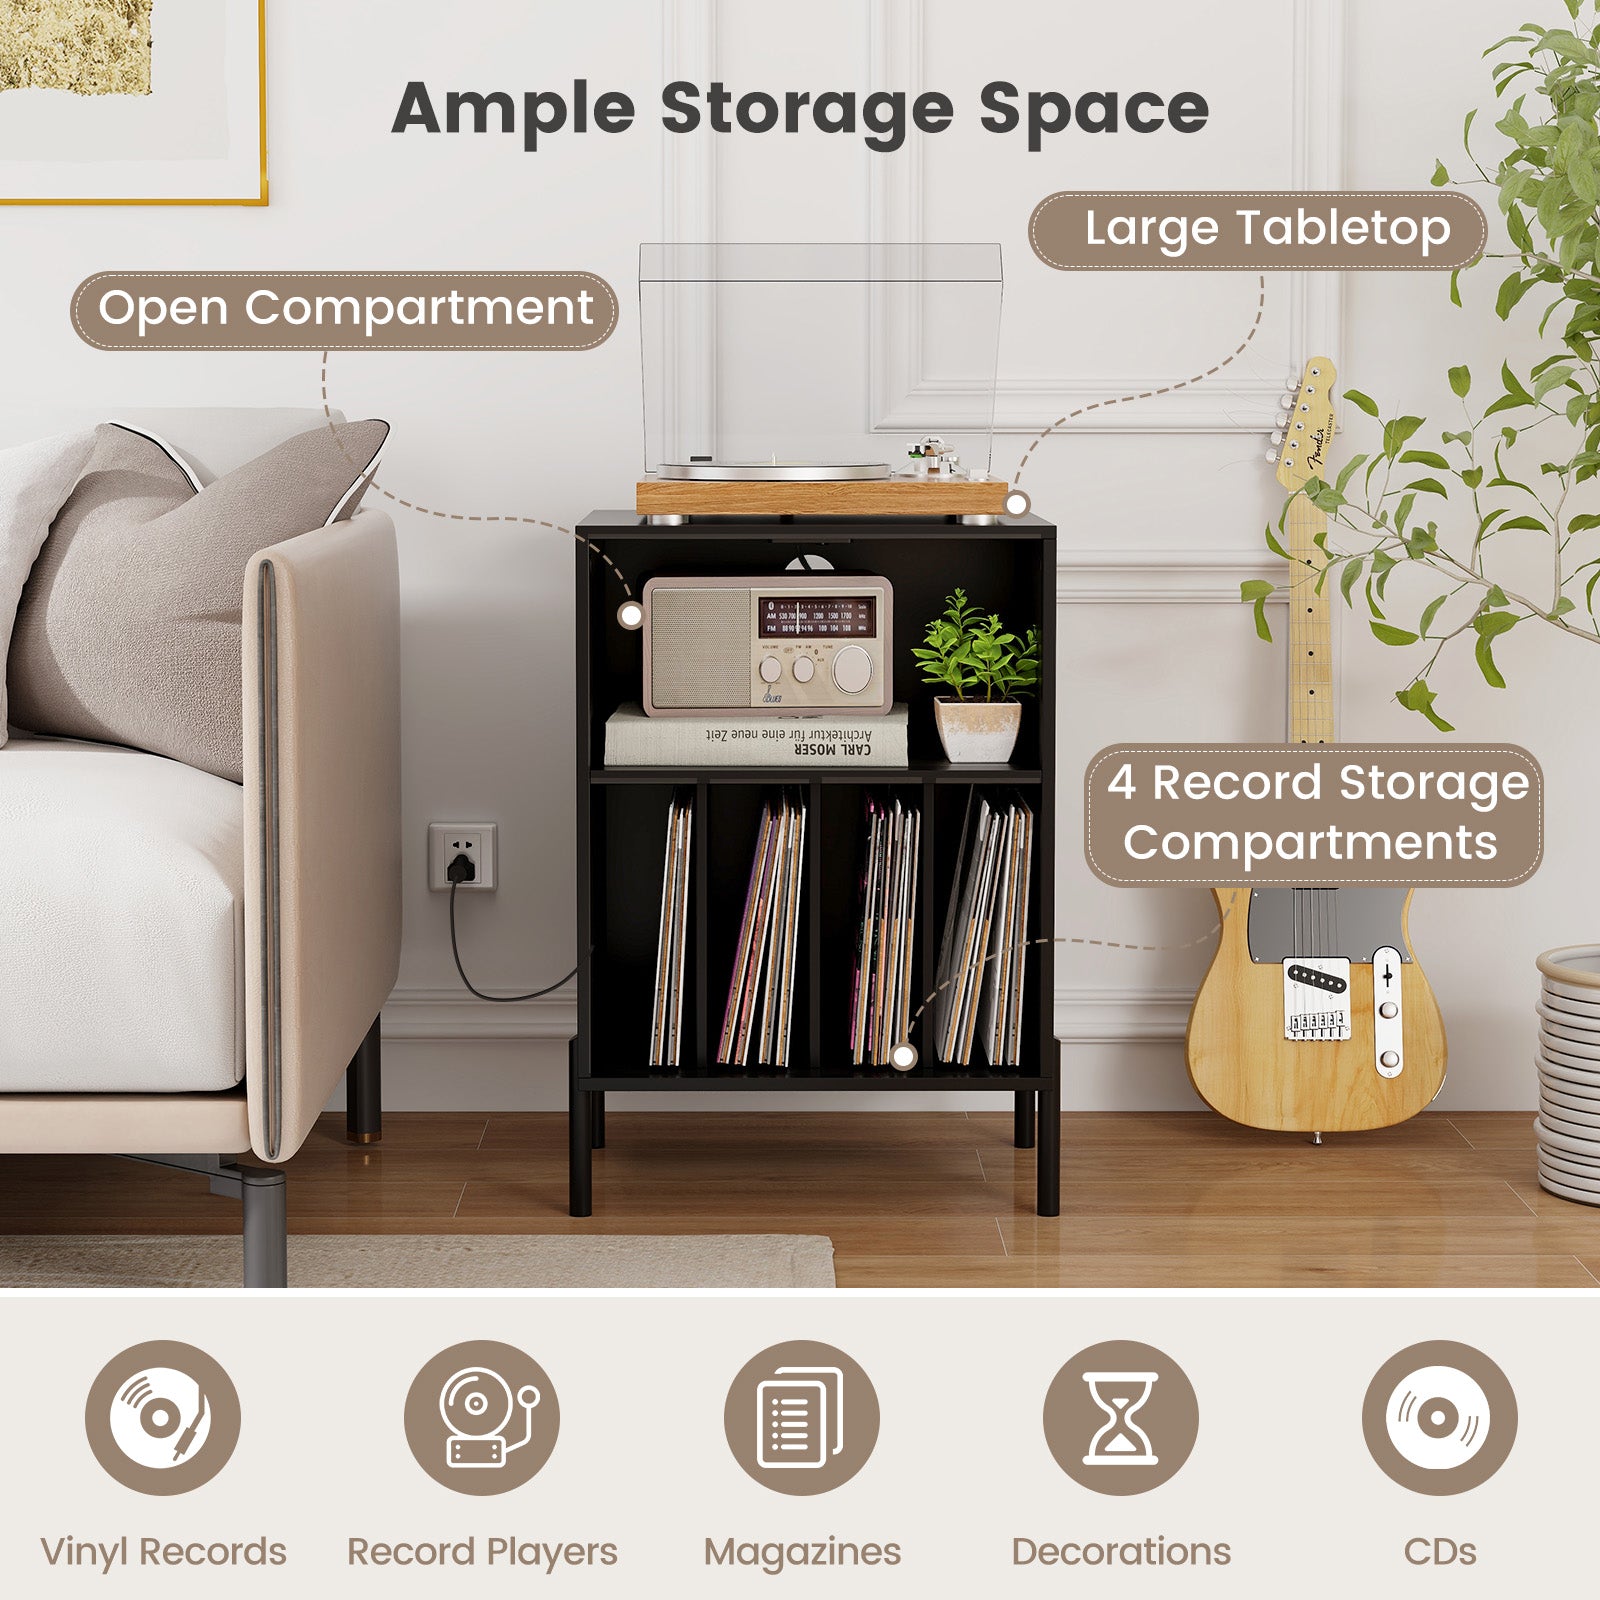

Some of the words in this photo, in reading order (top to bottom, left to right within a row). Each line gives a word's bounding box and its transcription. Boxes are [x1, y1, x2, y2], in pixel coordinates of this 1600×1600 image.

[767, 612, 777, 620] AM
[706, 729, 728, 742] Zeit
[731, 729, 758, 740] neue
[761, 729, 786, 741] eine
[789, 730, 805, 743] für
[808, 730, 872, 744] Architektur
[794, 743, 836, 756] MOSER
[840, 743, 872, 756] CARL
